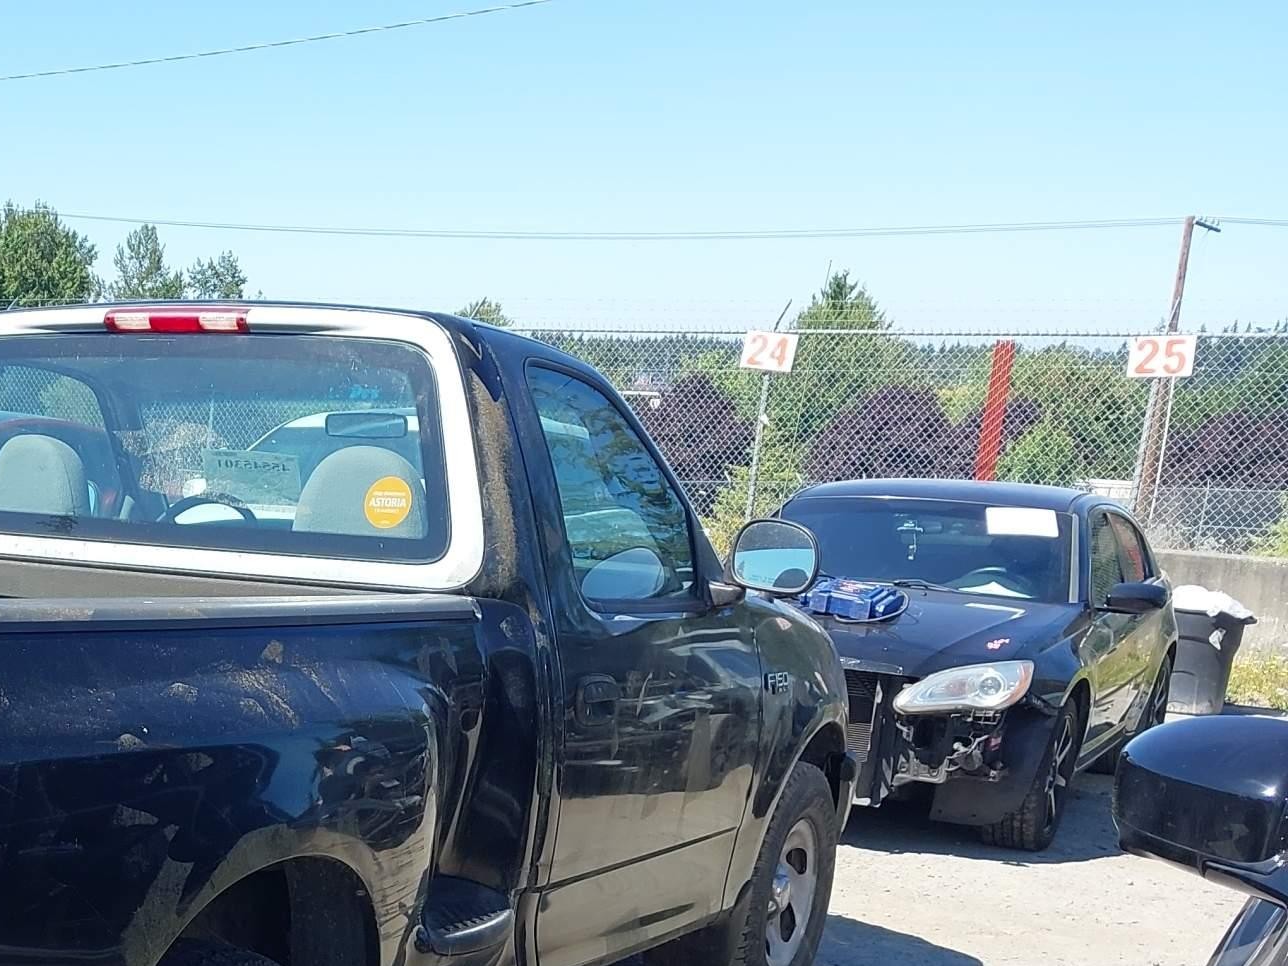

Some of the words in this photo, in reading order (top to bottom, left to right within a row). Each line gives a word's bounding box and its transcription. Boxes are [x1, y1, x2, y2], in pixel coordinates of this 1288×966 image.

[746, 334, 789, 367] 24
[1134, 339, 1187, 374] 25
[369, 497, 406, 508] ASTORIA
